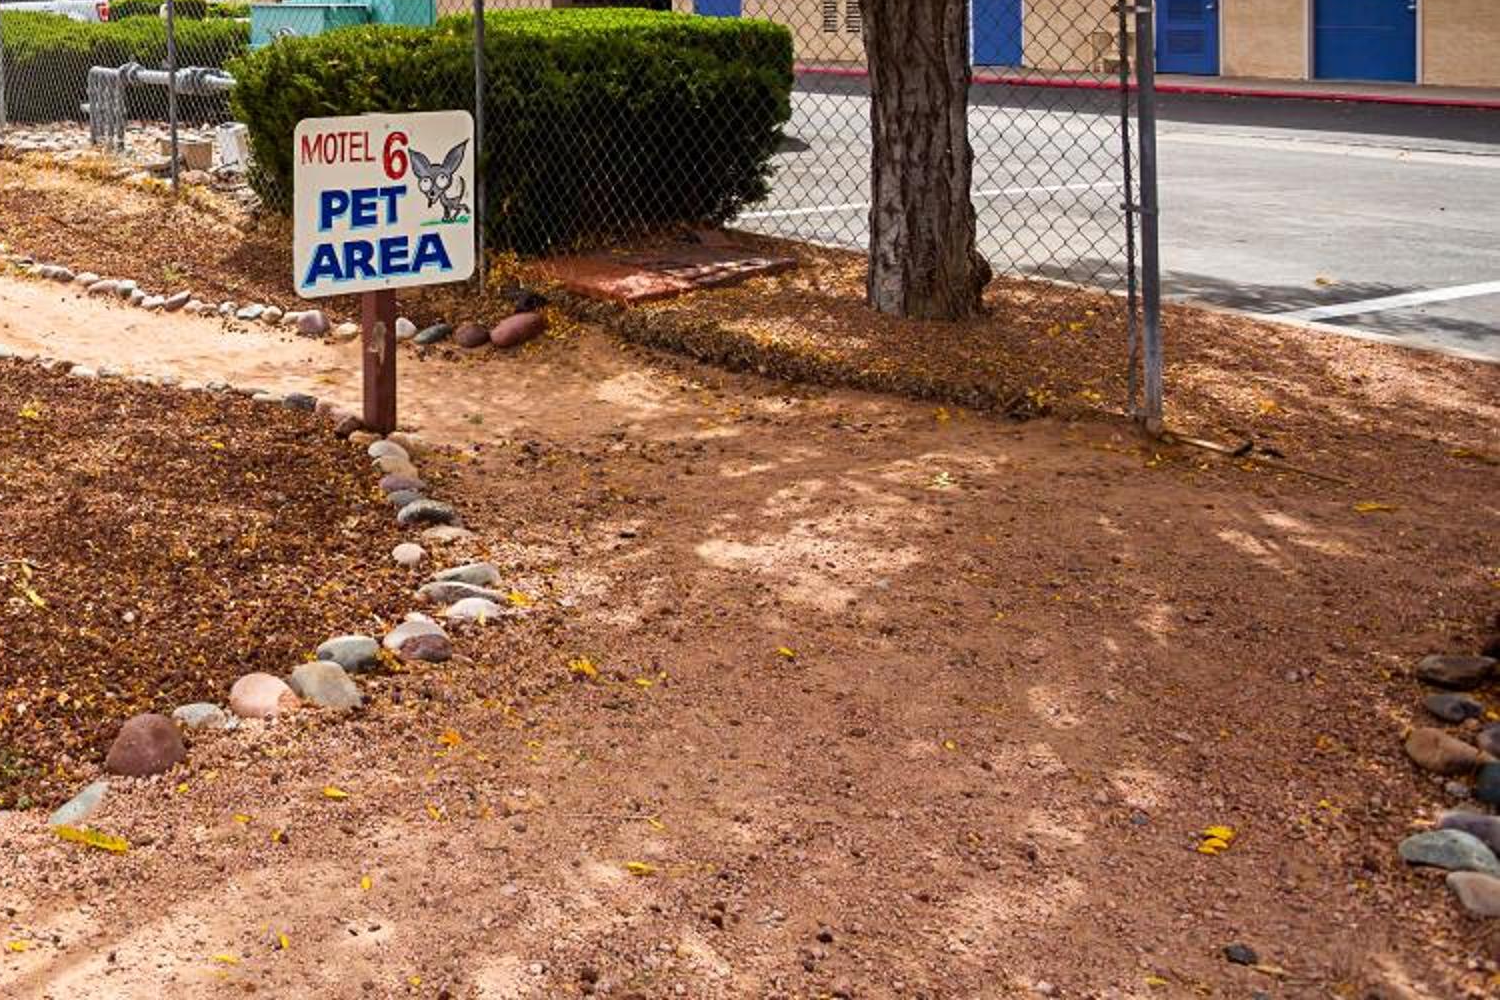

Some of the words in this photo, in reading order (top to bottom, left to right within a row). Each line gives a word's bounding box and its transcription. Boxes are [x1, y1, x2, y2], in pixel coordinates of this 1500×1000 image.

[301, 132, 376, 164] MOTEL
[383, 131, 408, 180] 6
[318, 185, 407, 231] PET
[302, 232, 452, 287] AREA
